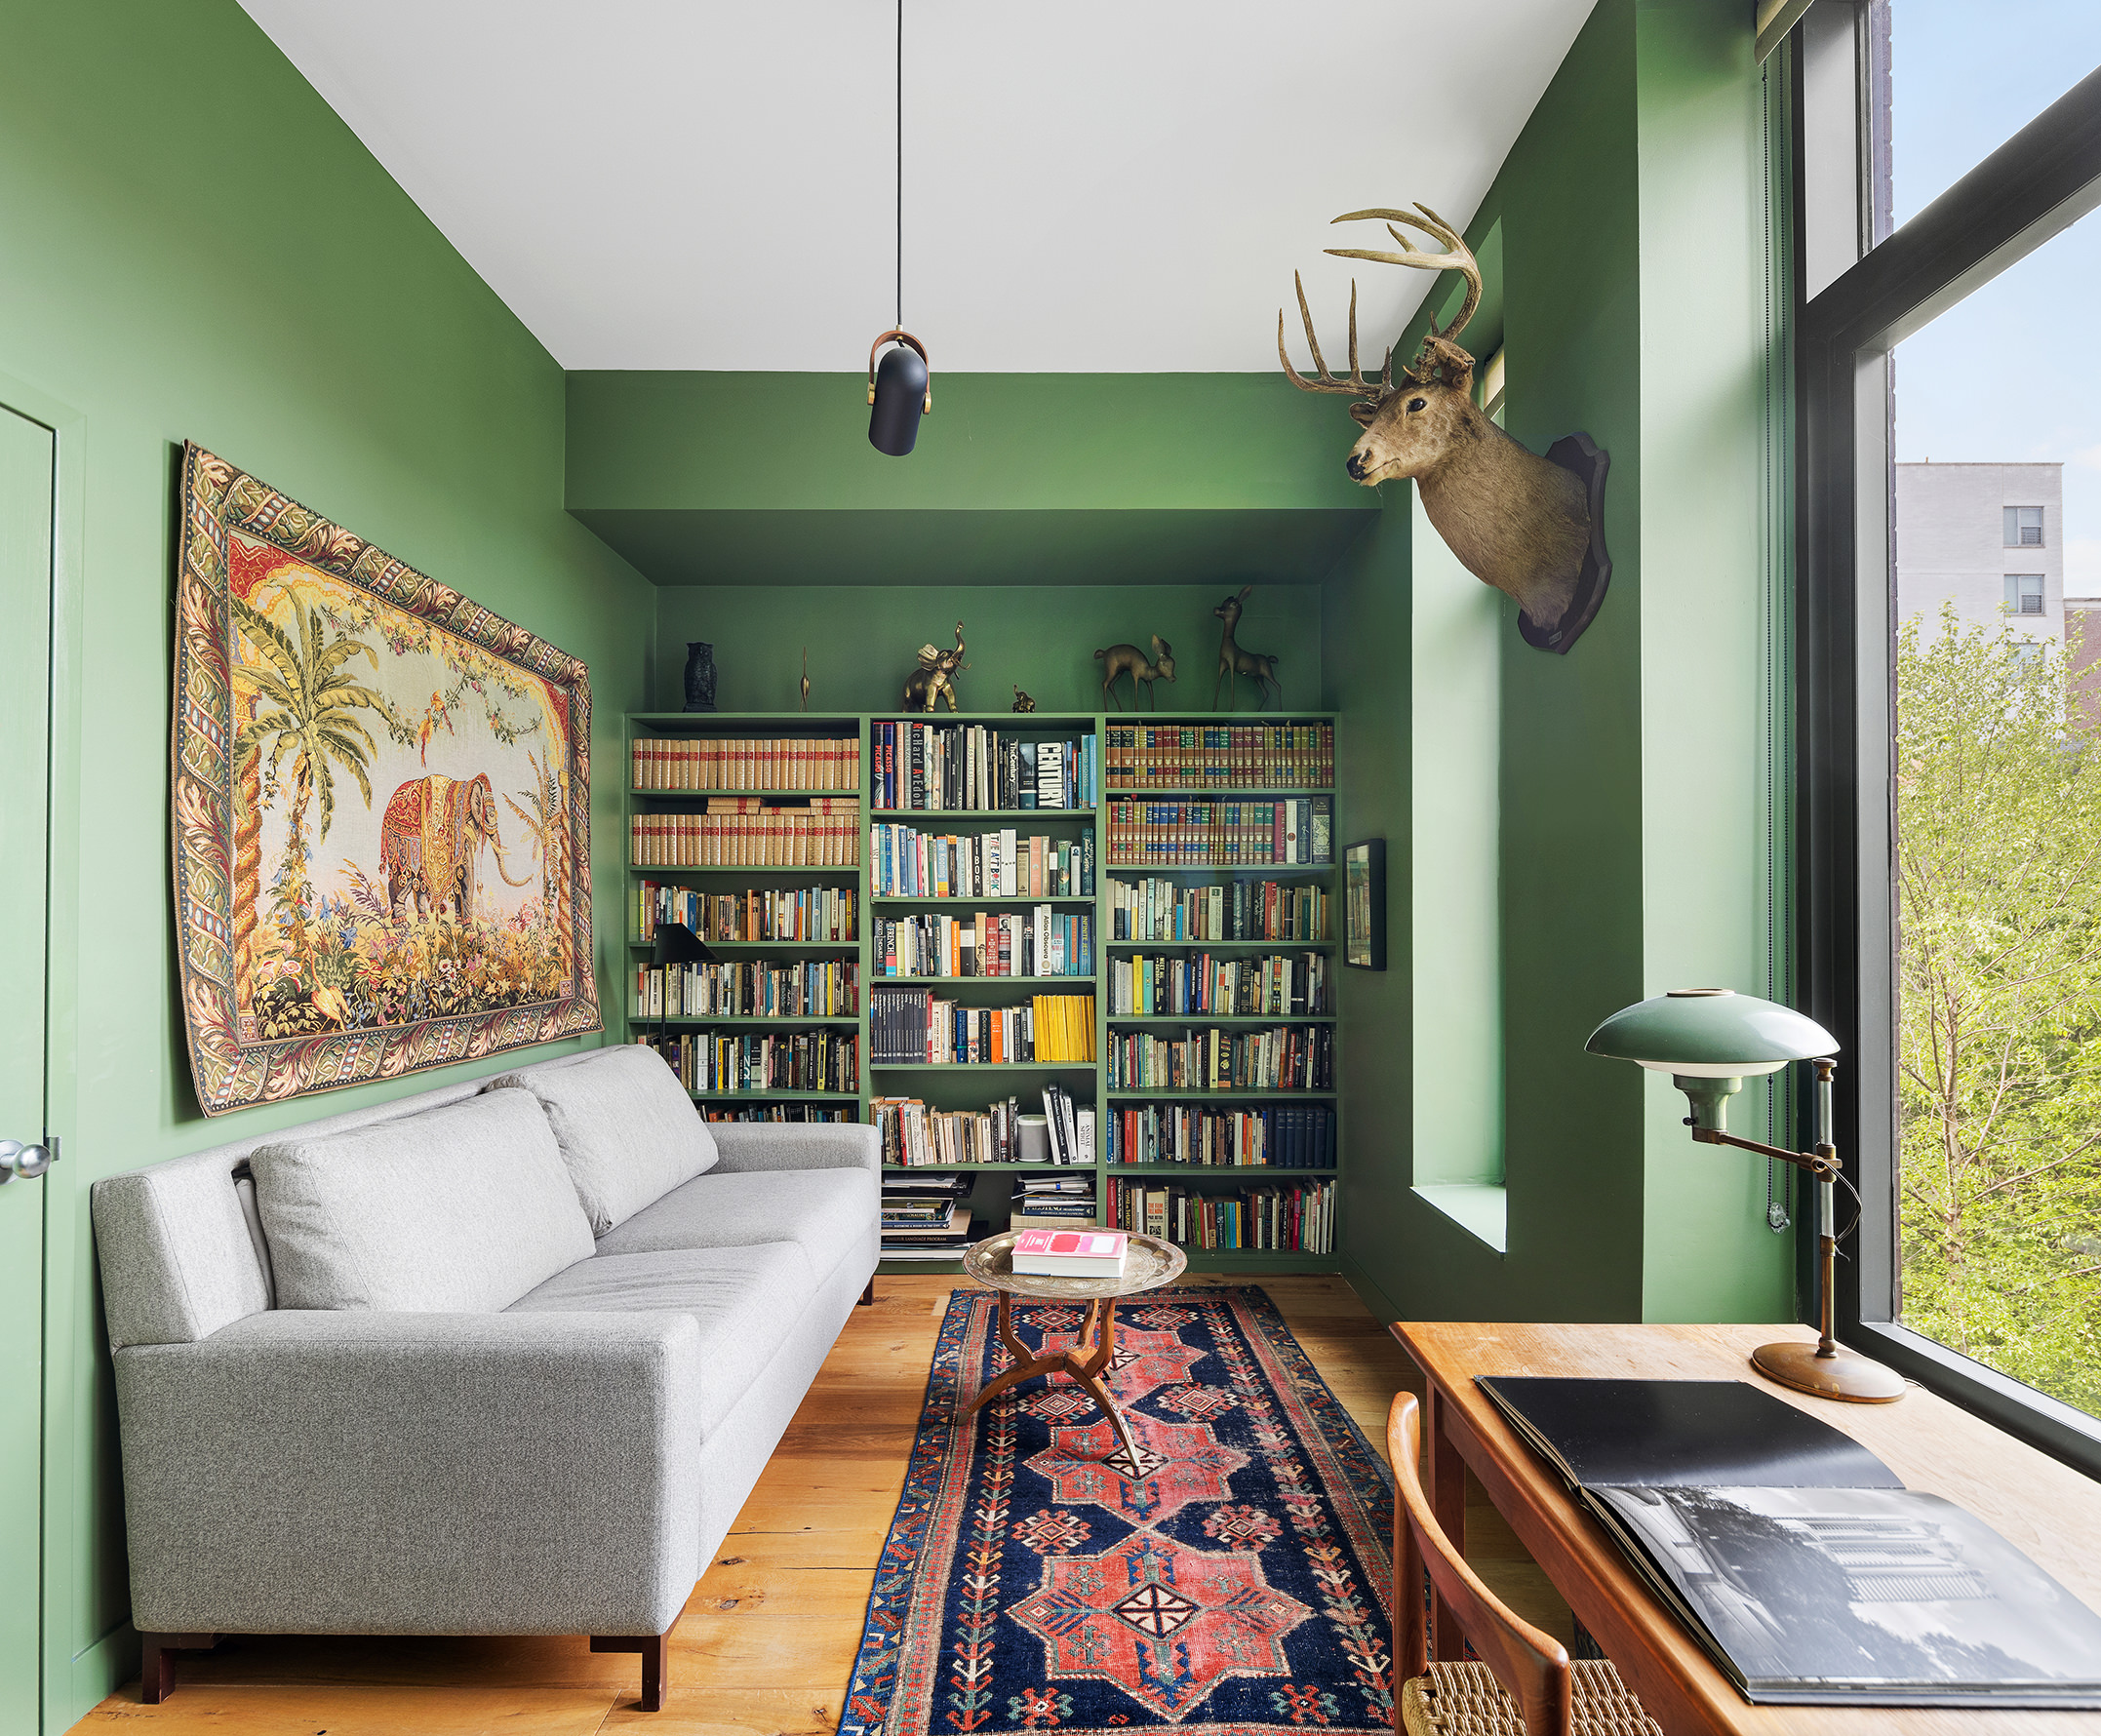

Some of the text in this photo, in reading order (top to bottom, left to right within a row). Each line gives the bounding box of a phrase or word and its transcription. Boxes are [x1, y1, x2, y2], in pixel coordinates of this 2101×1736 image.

[913, 723, 923, 806] RicHard AvEdoN
[1037, 742, 1063, 808] CENTURY
